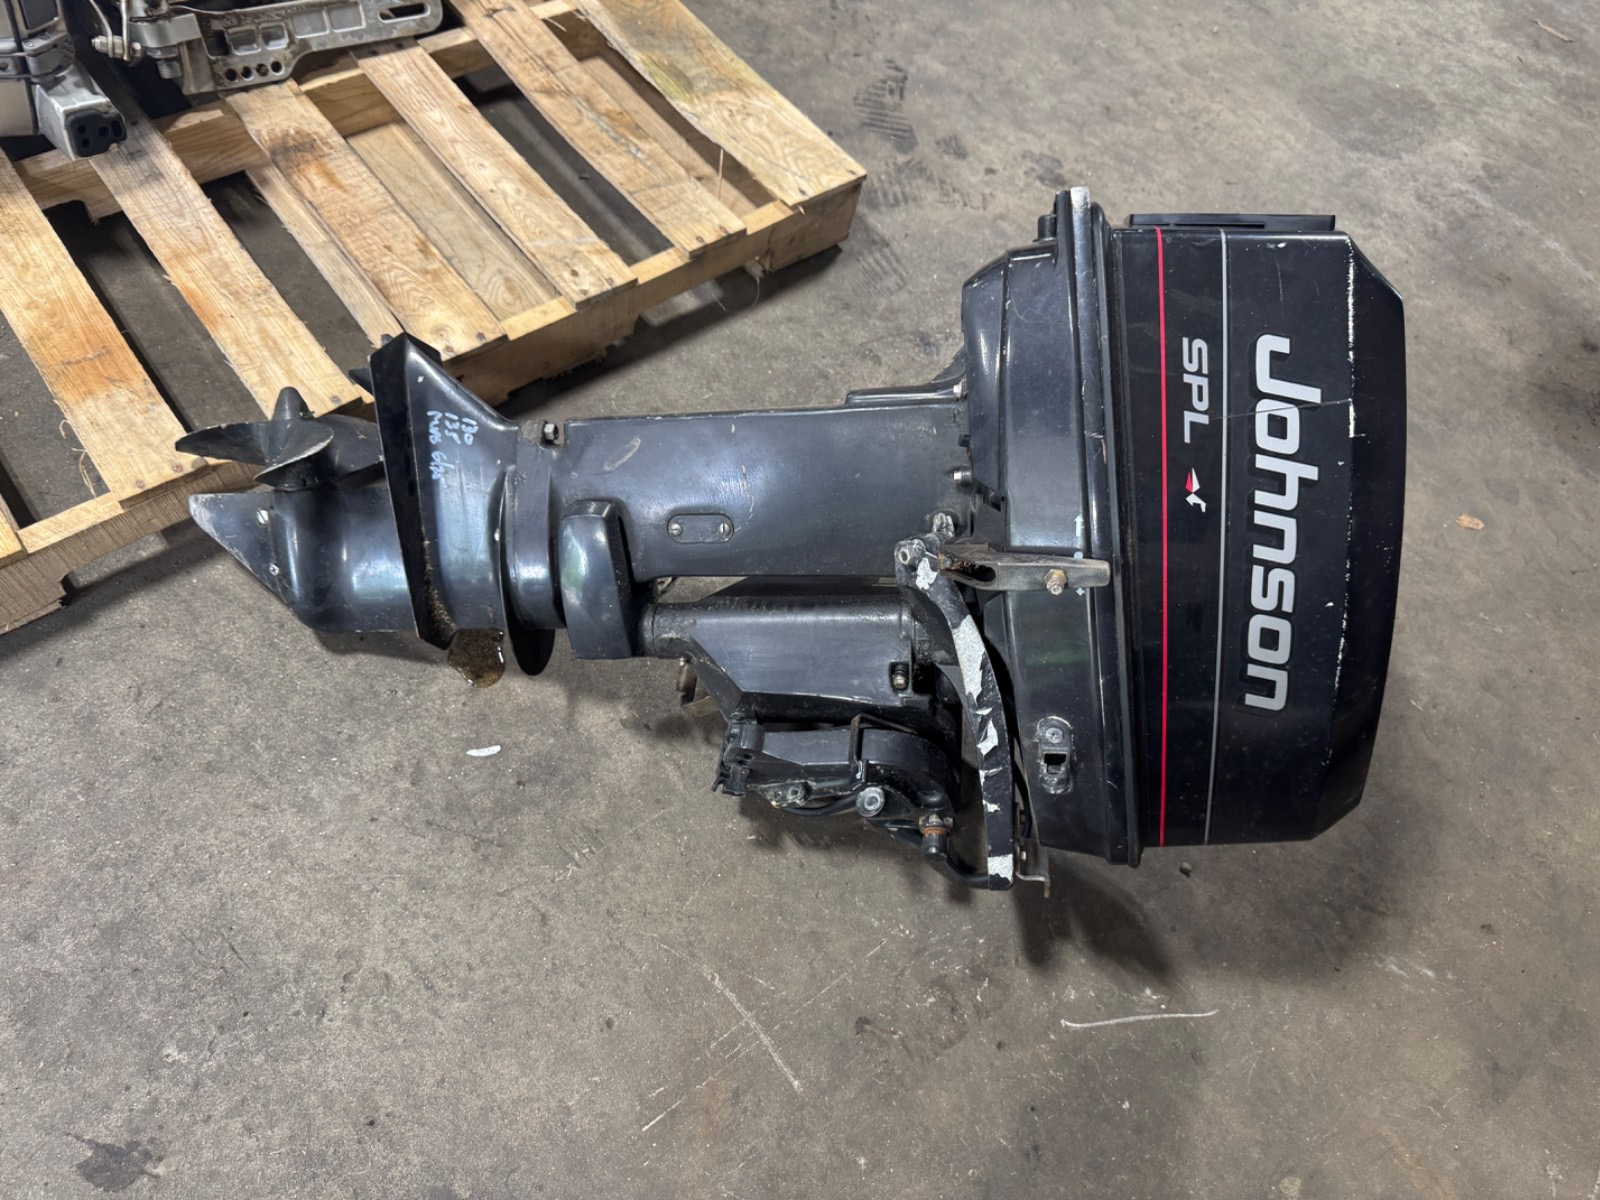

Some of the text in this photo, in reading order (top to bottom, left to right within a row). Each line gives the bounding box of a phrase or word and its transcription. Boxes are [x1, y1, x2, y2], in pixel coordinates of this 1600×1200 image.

[461, 417, 479, 445] 130
[1182, 336, 1209, 444] SPL
[1245, 334, 1322, 711] Johnson
